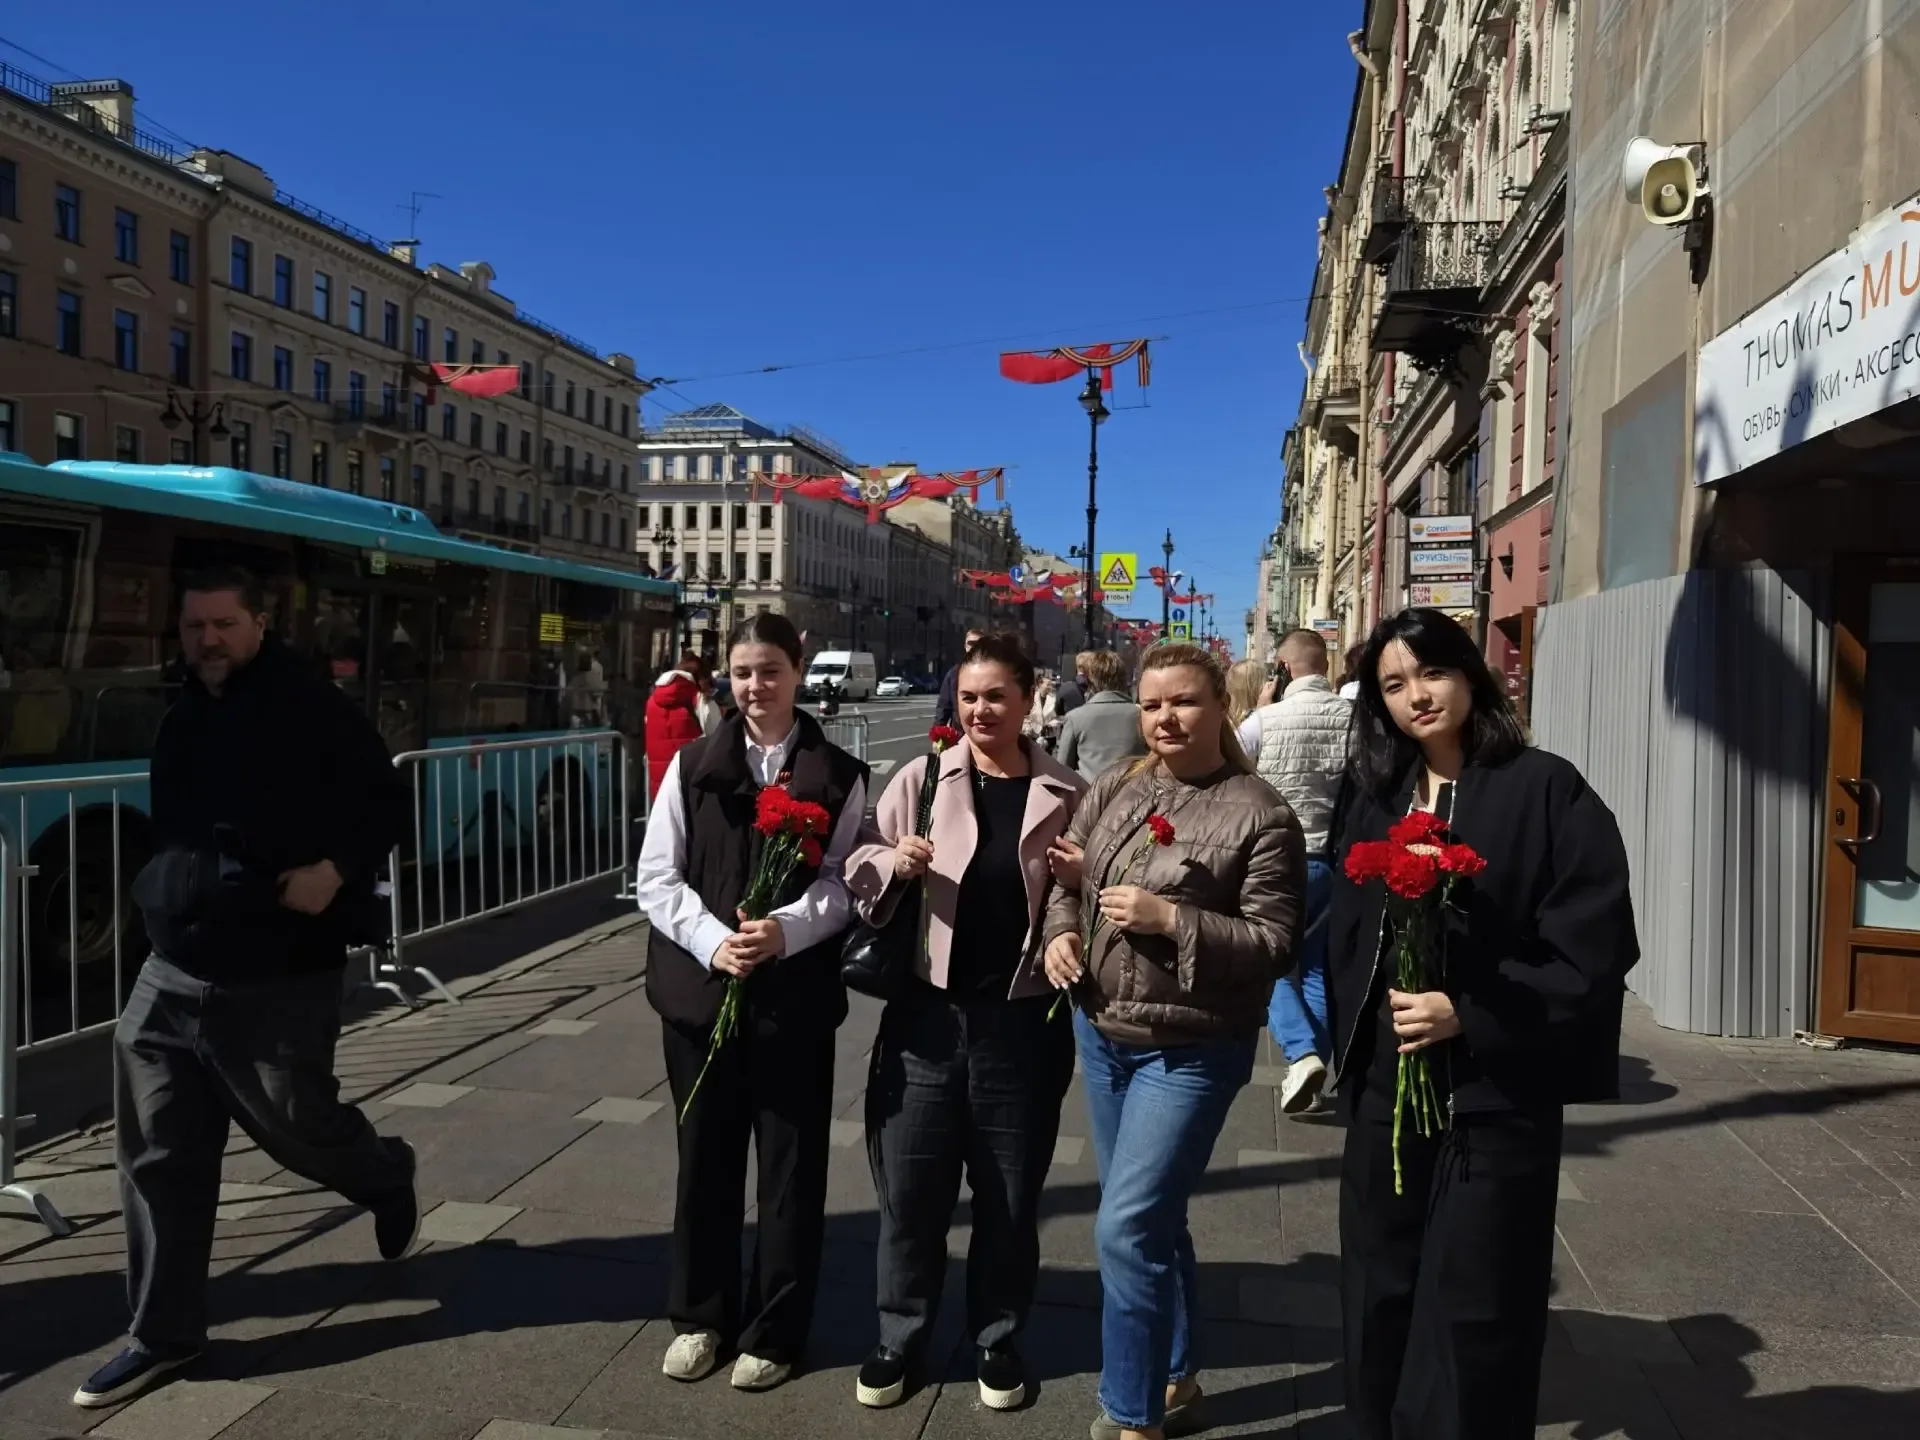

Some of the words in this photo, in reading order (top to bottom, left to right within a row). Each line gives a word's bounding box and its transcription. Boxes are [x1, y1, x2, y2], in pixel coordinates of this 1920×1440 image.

[1743, 275, 1856, 388] THOMAS
[1743, 404, 1781, 442] ОБУВЬ
[1790, 369, 1841, 418] СУМКИ
[1412, 586, 1431, 594] FUN
